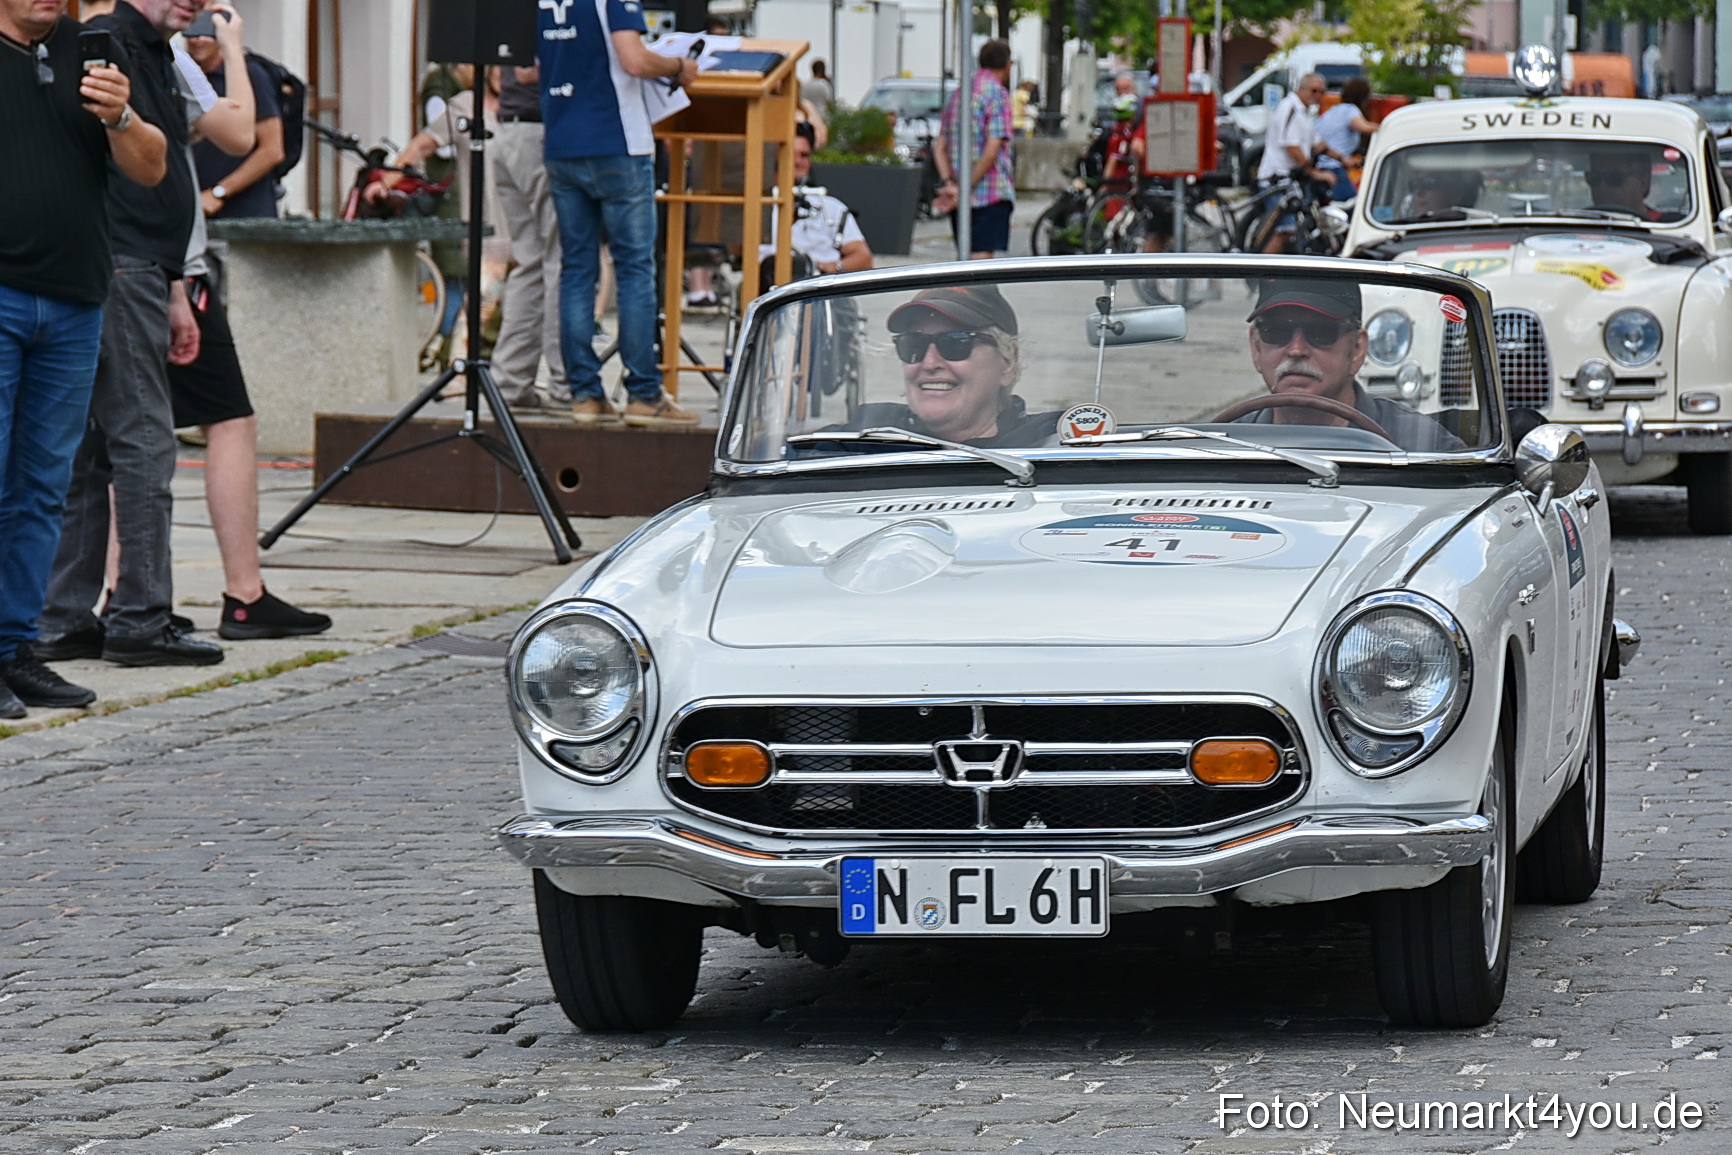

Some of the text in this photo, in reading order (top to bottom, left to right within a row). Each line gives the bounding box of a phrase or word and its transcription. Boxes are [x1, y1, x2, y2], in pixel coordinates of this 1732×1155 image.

[1462, 111, 1612, 130] SWEDEN
[1066, 407, 1108, 421] HONDA
[1104, 538, 1182, 551] 41
[877, 868, 908, 924] N
[950, 868, 1016, 924] FL
[1030, 868, 1101, 924] 6H
[852, 904, 866, 920] D
